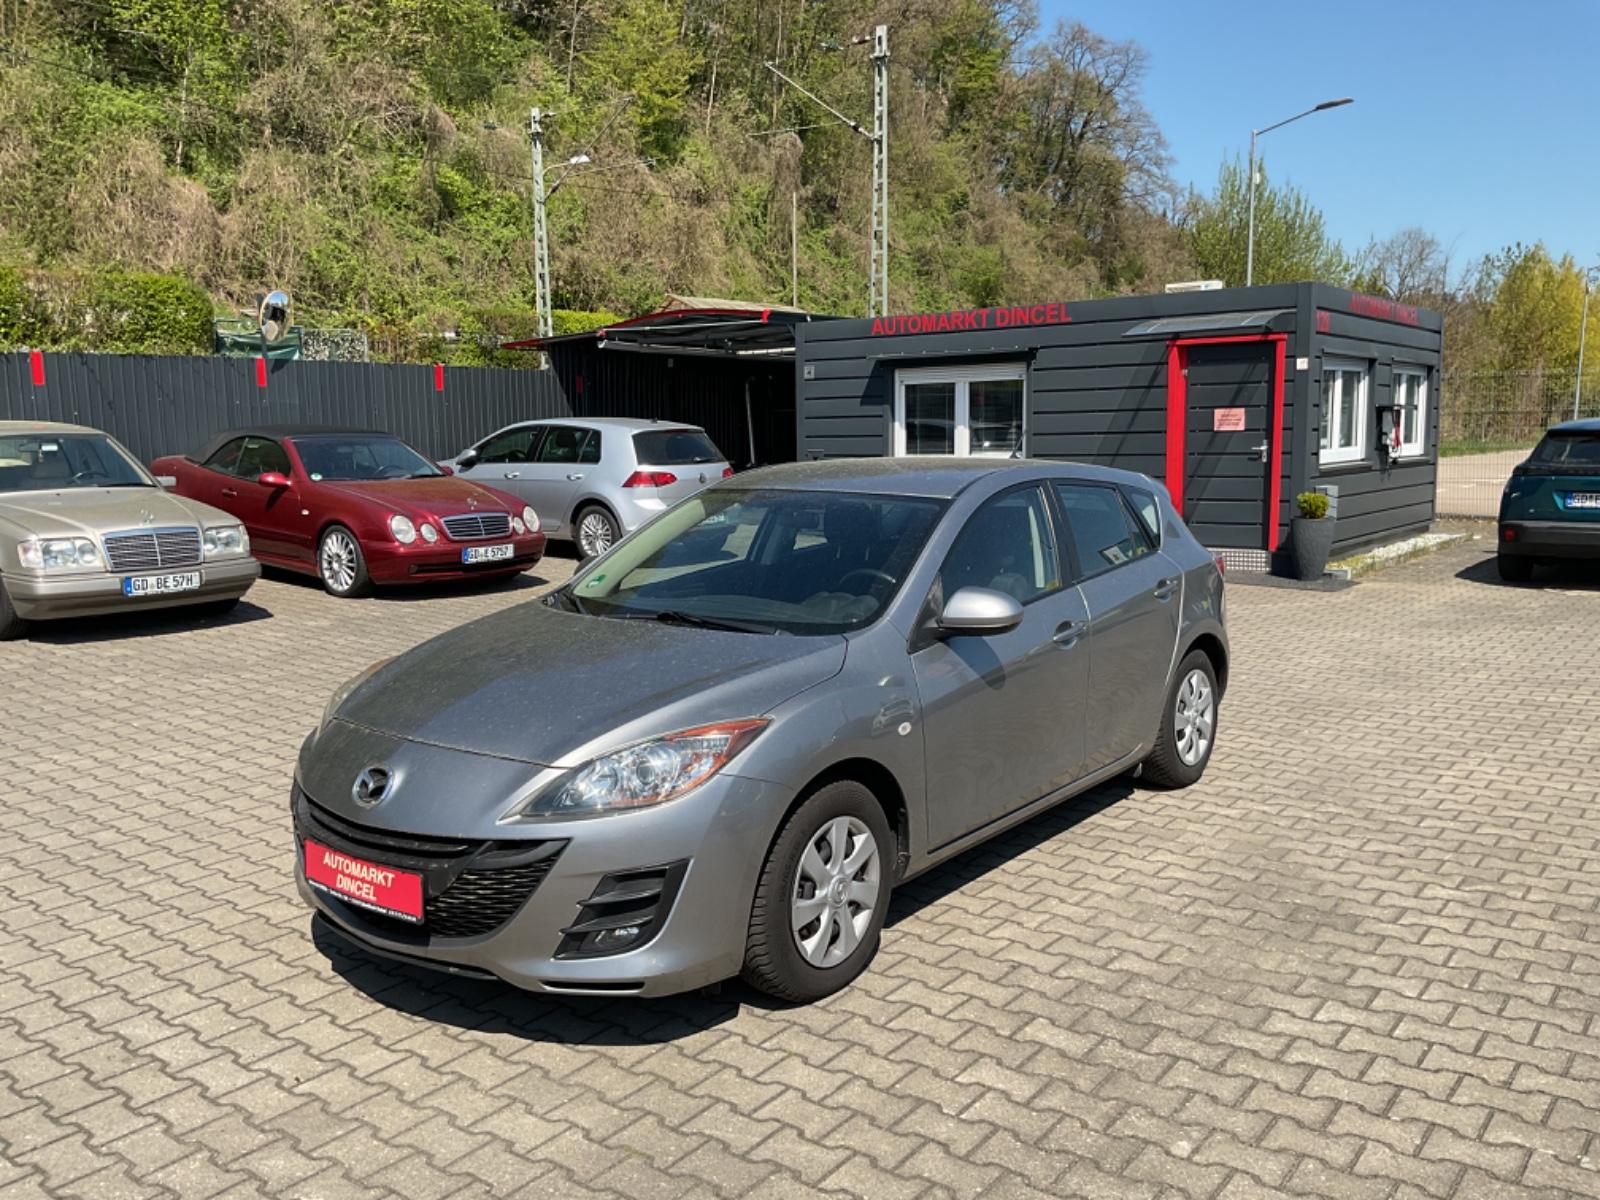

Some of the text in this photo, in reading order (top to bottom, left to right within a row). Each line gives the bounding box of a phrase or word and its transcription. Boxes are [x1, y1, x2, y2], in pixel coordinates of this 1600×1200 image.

[871, 303, 1072, 335] AUTOMARKT DINCEL
[133, 575, 193, 591] GD BE 57H
[323, 851, 395, 888] AUTOMARKT
[336, 874, 377, 901] DINCEL
